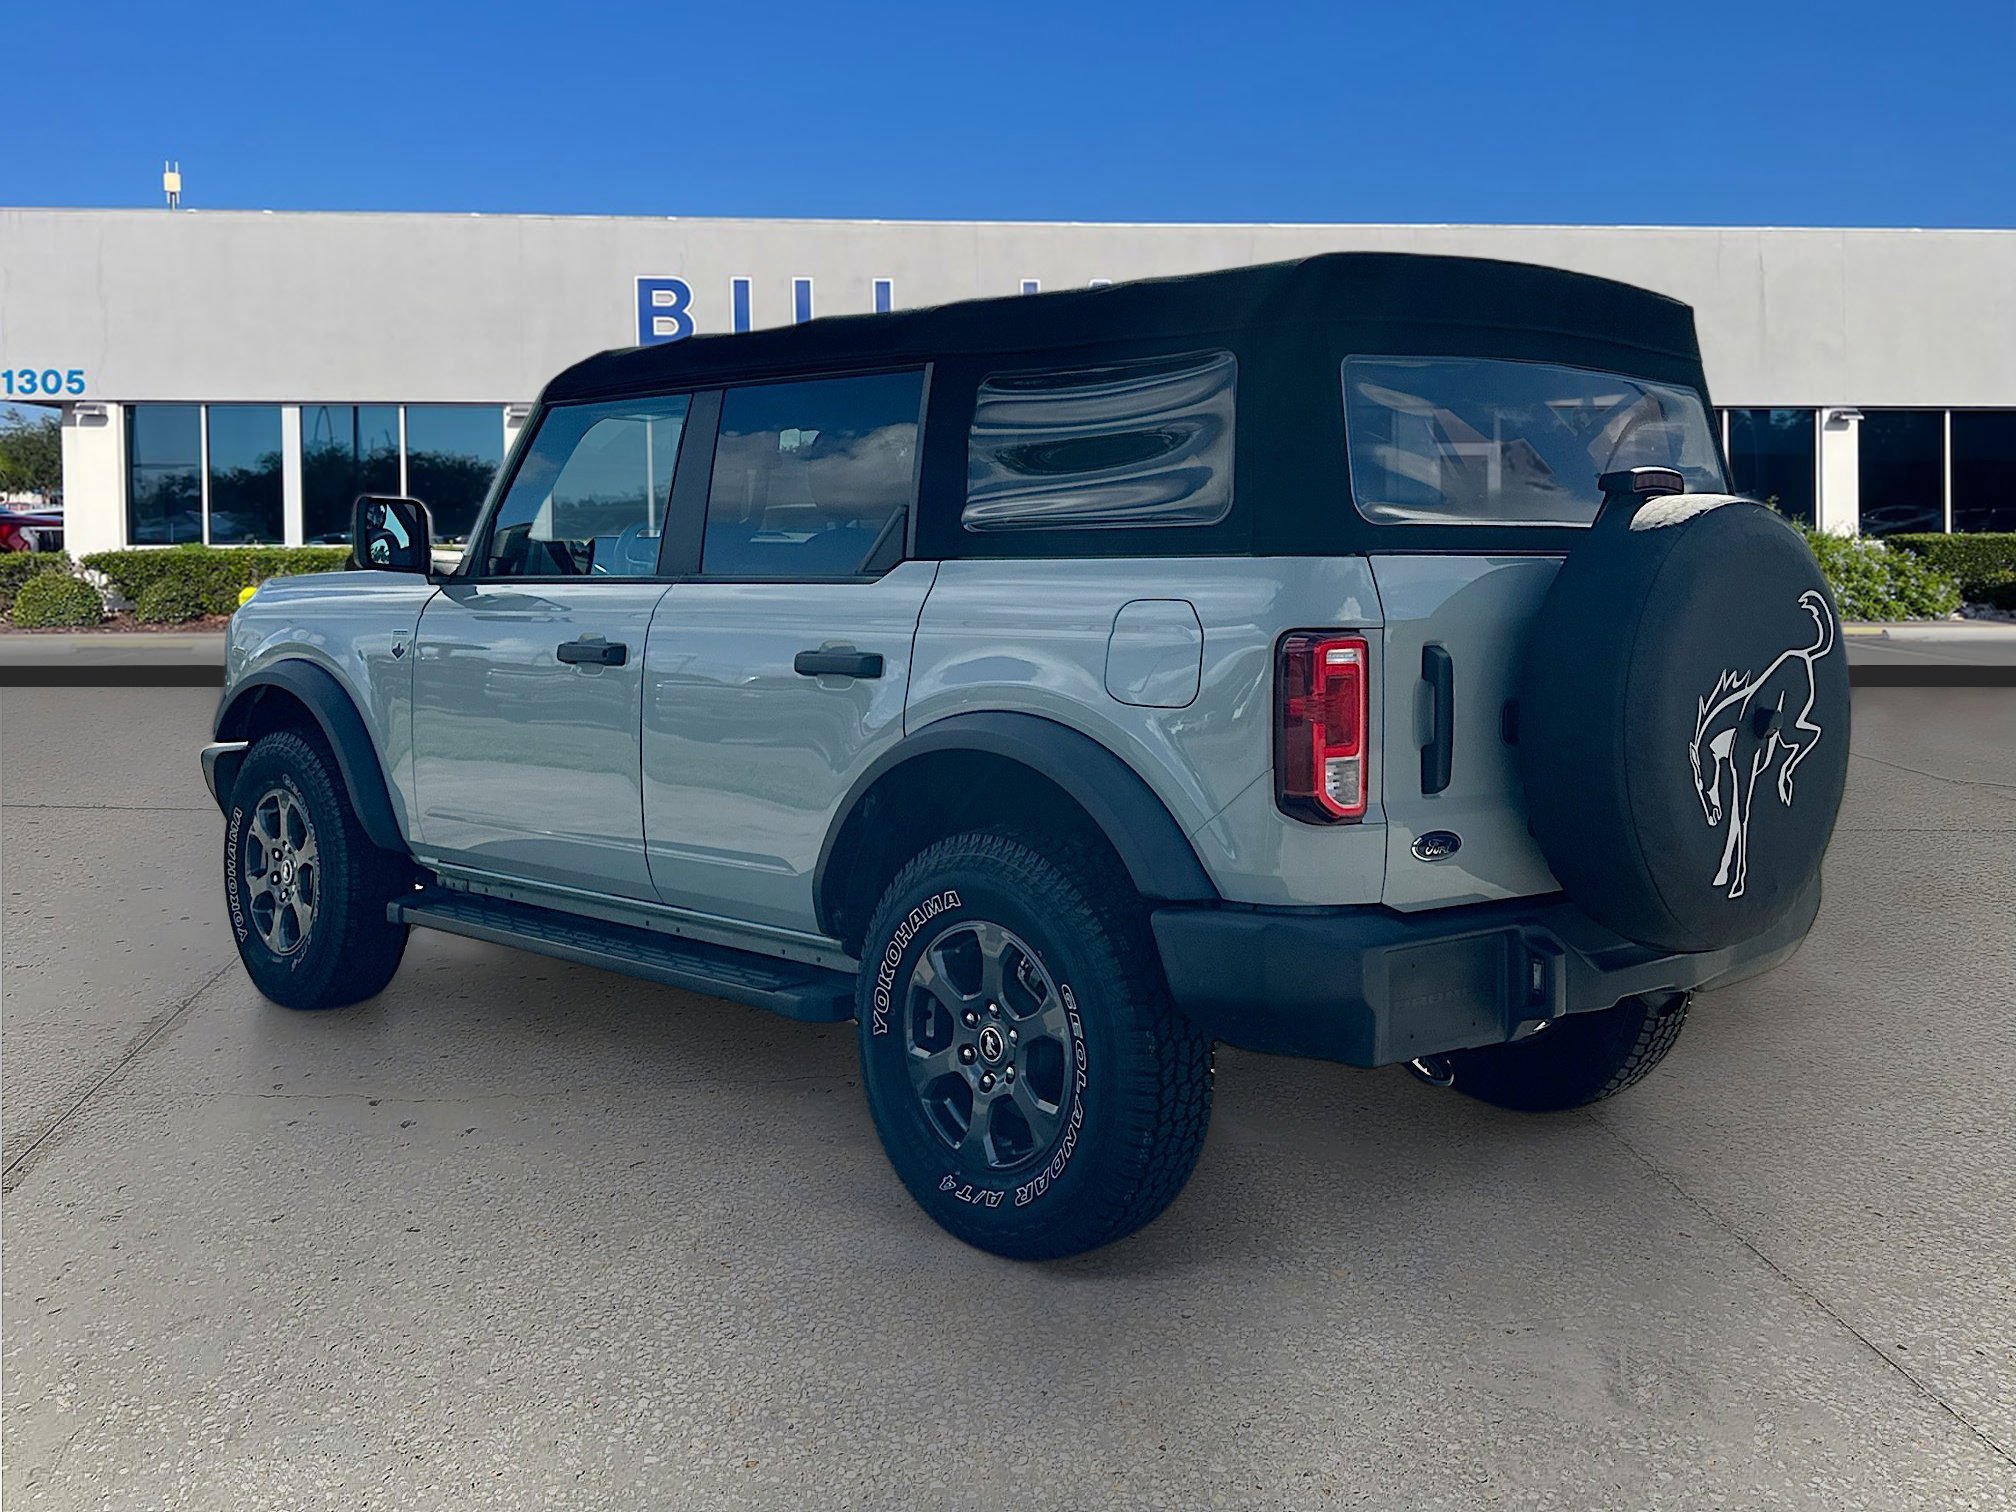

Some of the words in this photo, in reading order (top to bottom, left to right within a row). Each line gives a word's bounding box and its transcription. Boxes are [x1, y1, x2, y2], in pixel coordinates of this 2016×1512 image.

[1, 368, 85, 395] 1305
[227, 807, 248, 942] YOKOHAMA
[872, 890, 962, 1036] YOKOHAMA
[1014, 984, 1088, 1207] GEOLANDAR
